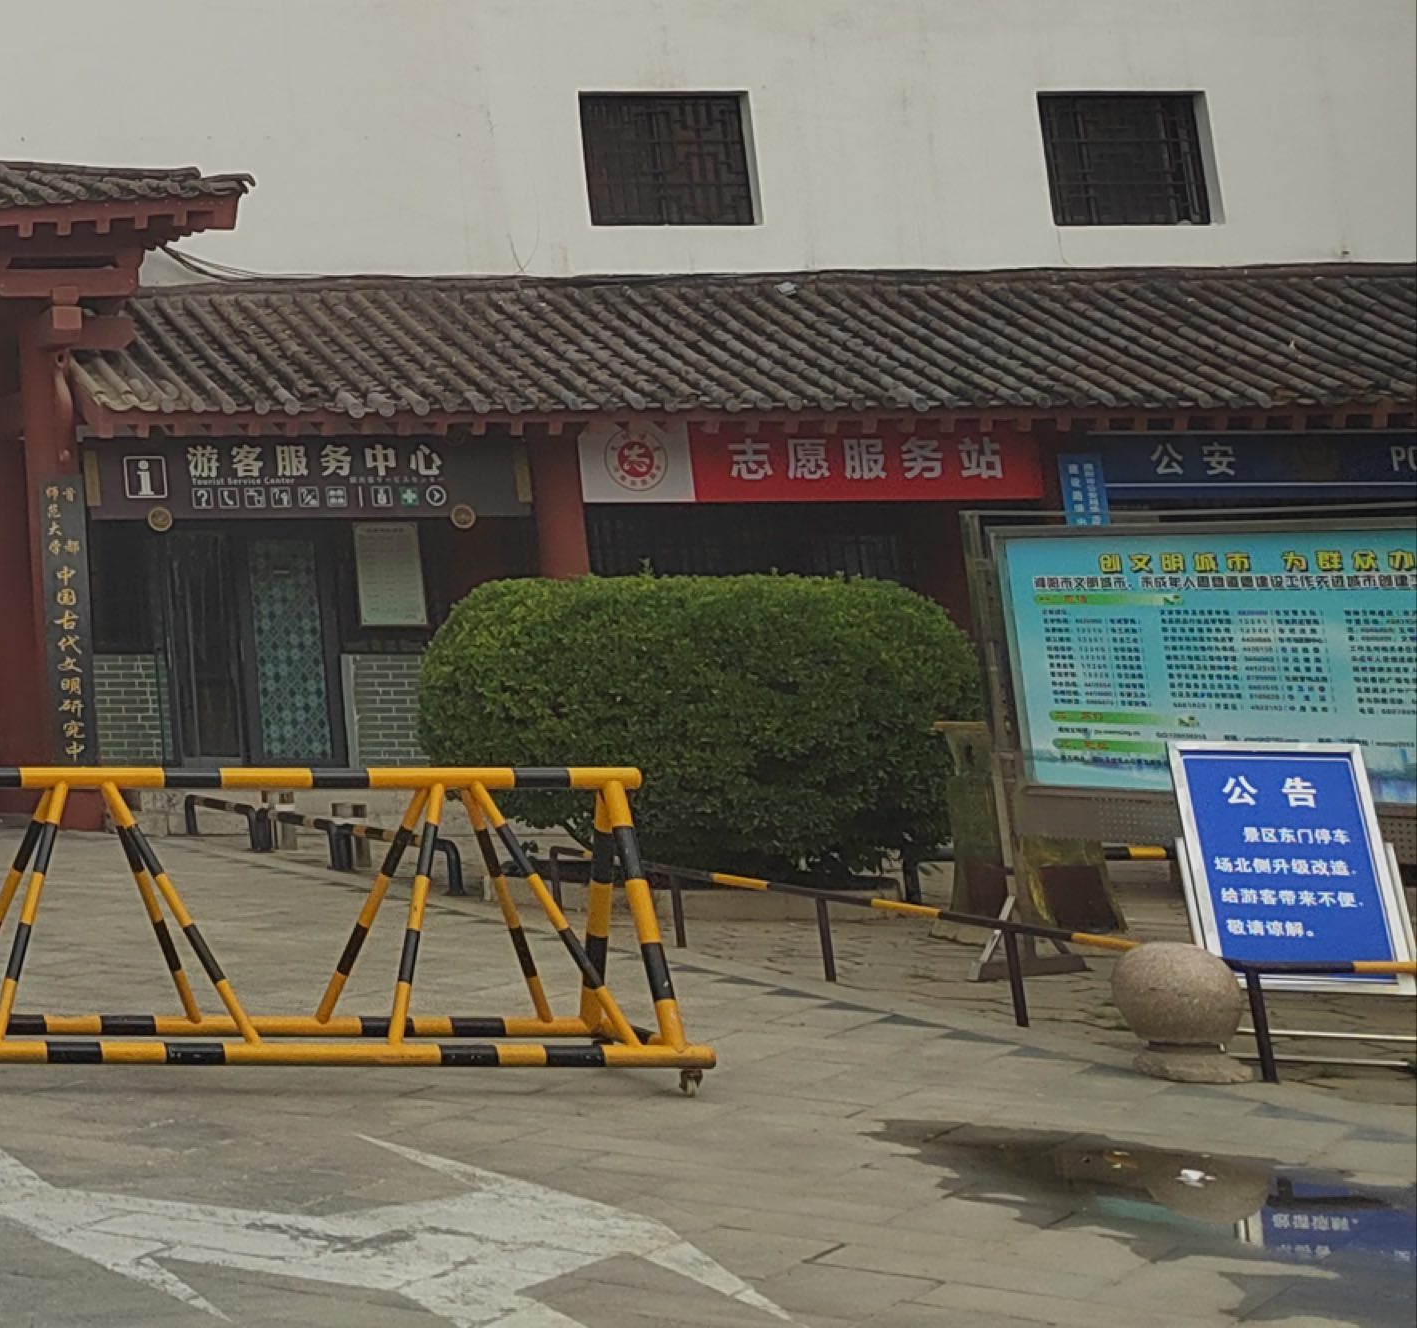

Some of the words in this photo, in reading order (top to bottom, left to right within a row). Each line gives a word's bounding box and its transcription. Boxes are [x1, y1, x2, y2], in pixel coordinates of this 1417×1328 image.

[187, 443, 444, 479] 游客服务中心
[729, 436, 1004, 481] 志愿服务站
[1150, 441, 1236, 476] 公安
[1222, 775, 1317, 809] 公告
[1242, 826, 1352, 846] 景区东门停车
